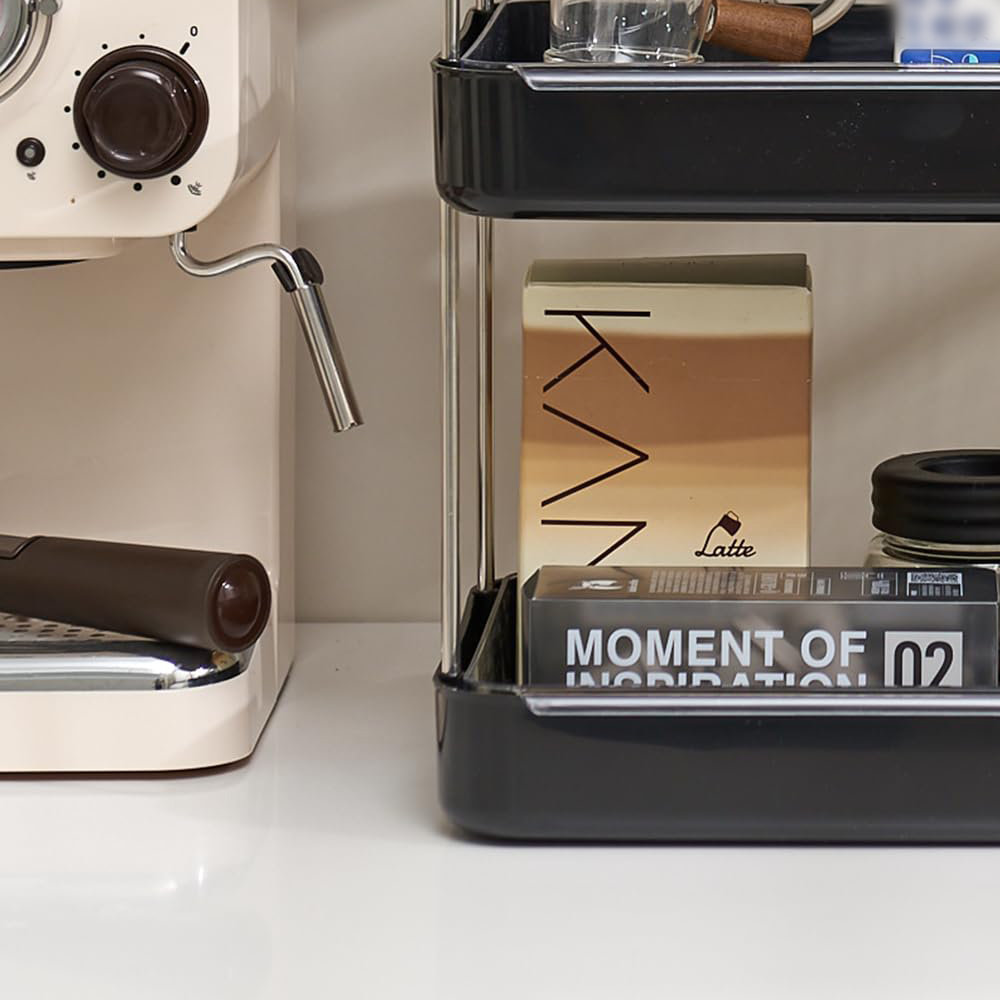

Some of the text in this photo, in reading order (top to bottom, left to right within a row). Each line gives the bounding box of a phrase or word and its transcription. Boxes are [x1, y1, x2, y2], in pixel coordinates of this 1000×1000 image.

[694, 527, 756, 558] Latte
[566, 628, 867, 668] MOMENT OF
